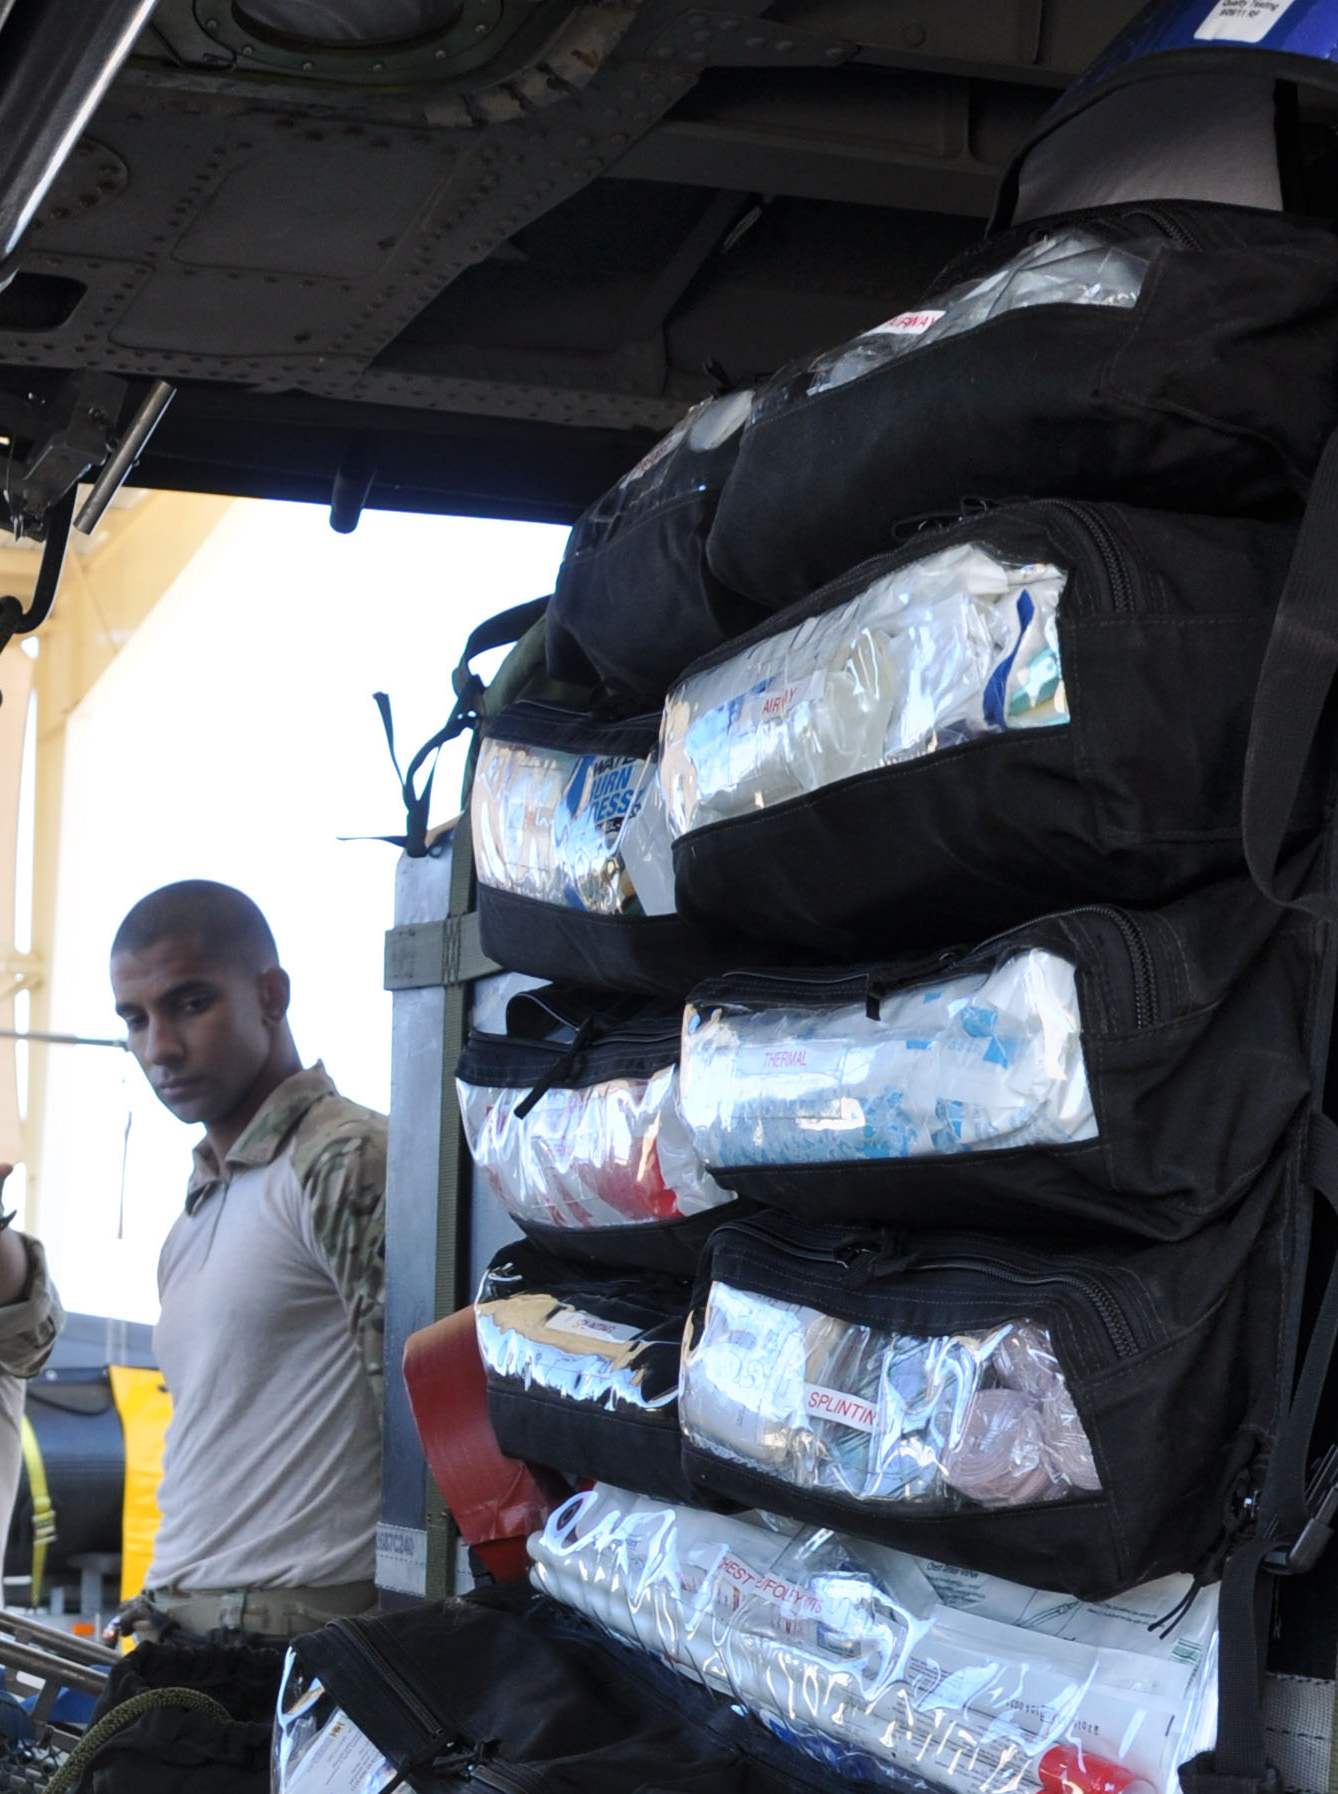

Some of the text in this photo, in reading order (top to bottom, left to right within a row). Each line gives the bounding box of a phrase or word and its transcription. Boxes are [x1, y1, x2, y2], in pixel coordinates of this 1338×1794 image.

[764, 1049, 807, 1068] THERMAL
[808, 1391, 877, 1427] SPLINTIN
[719, 1556, 755, 1586] HEST
